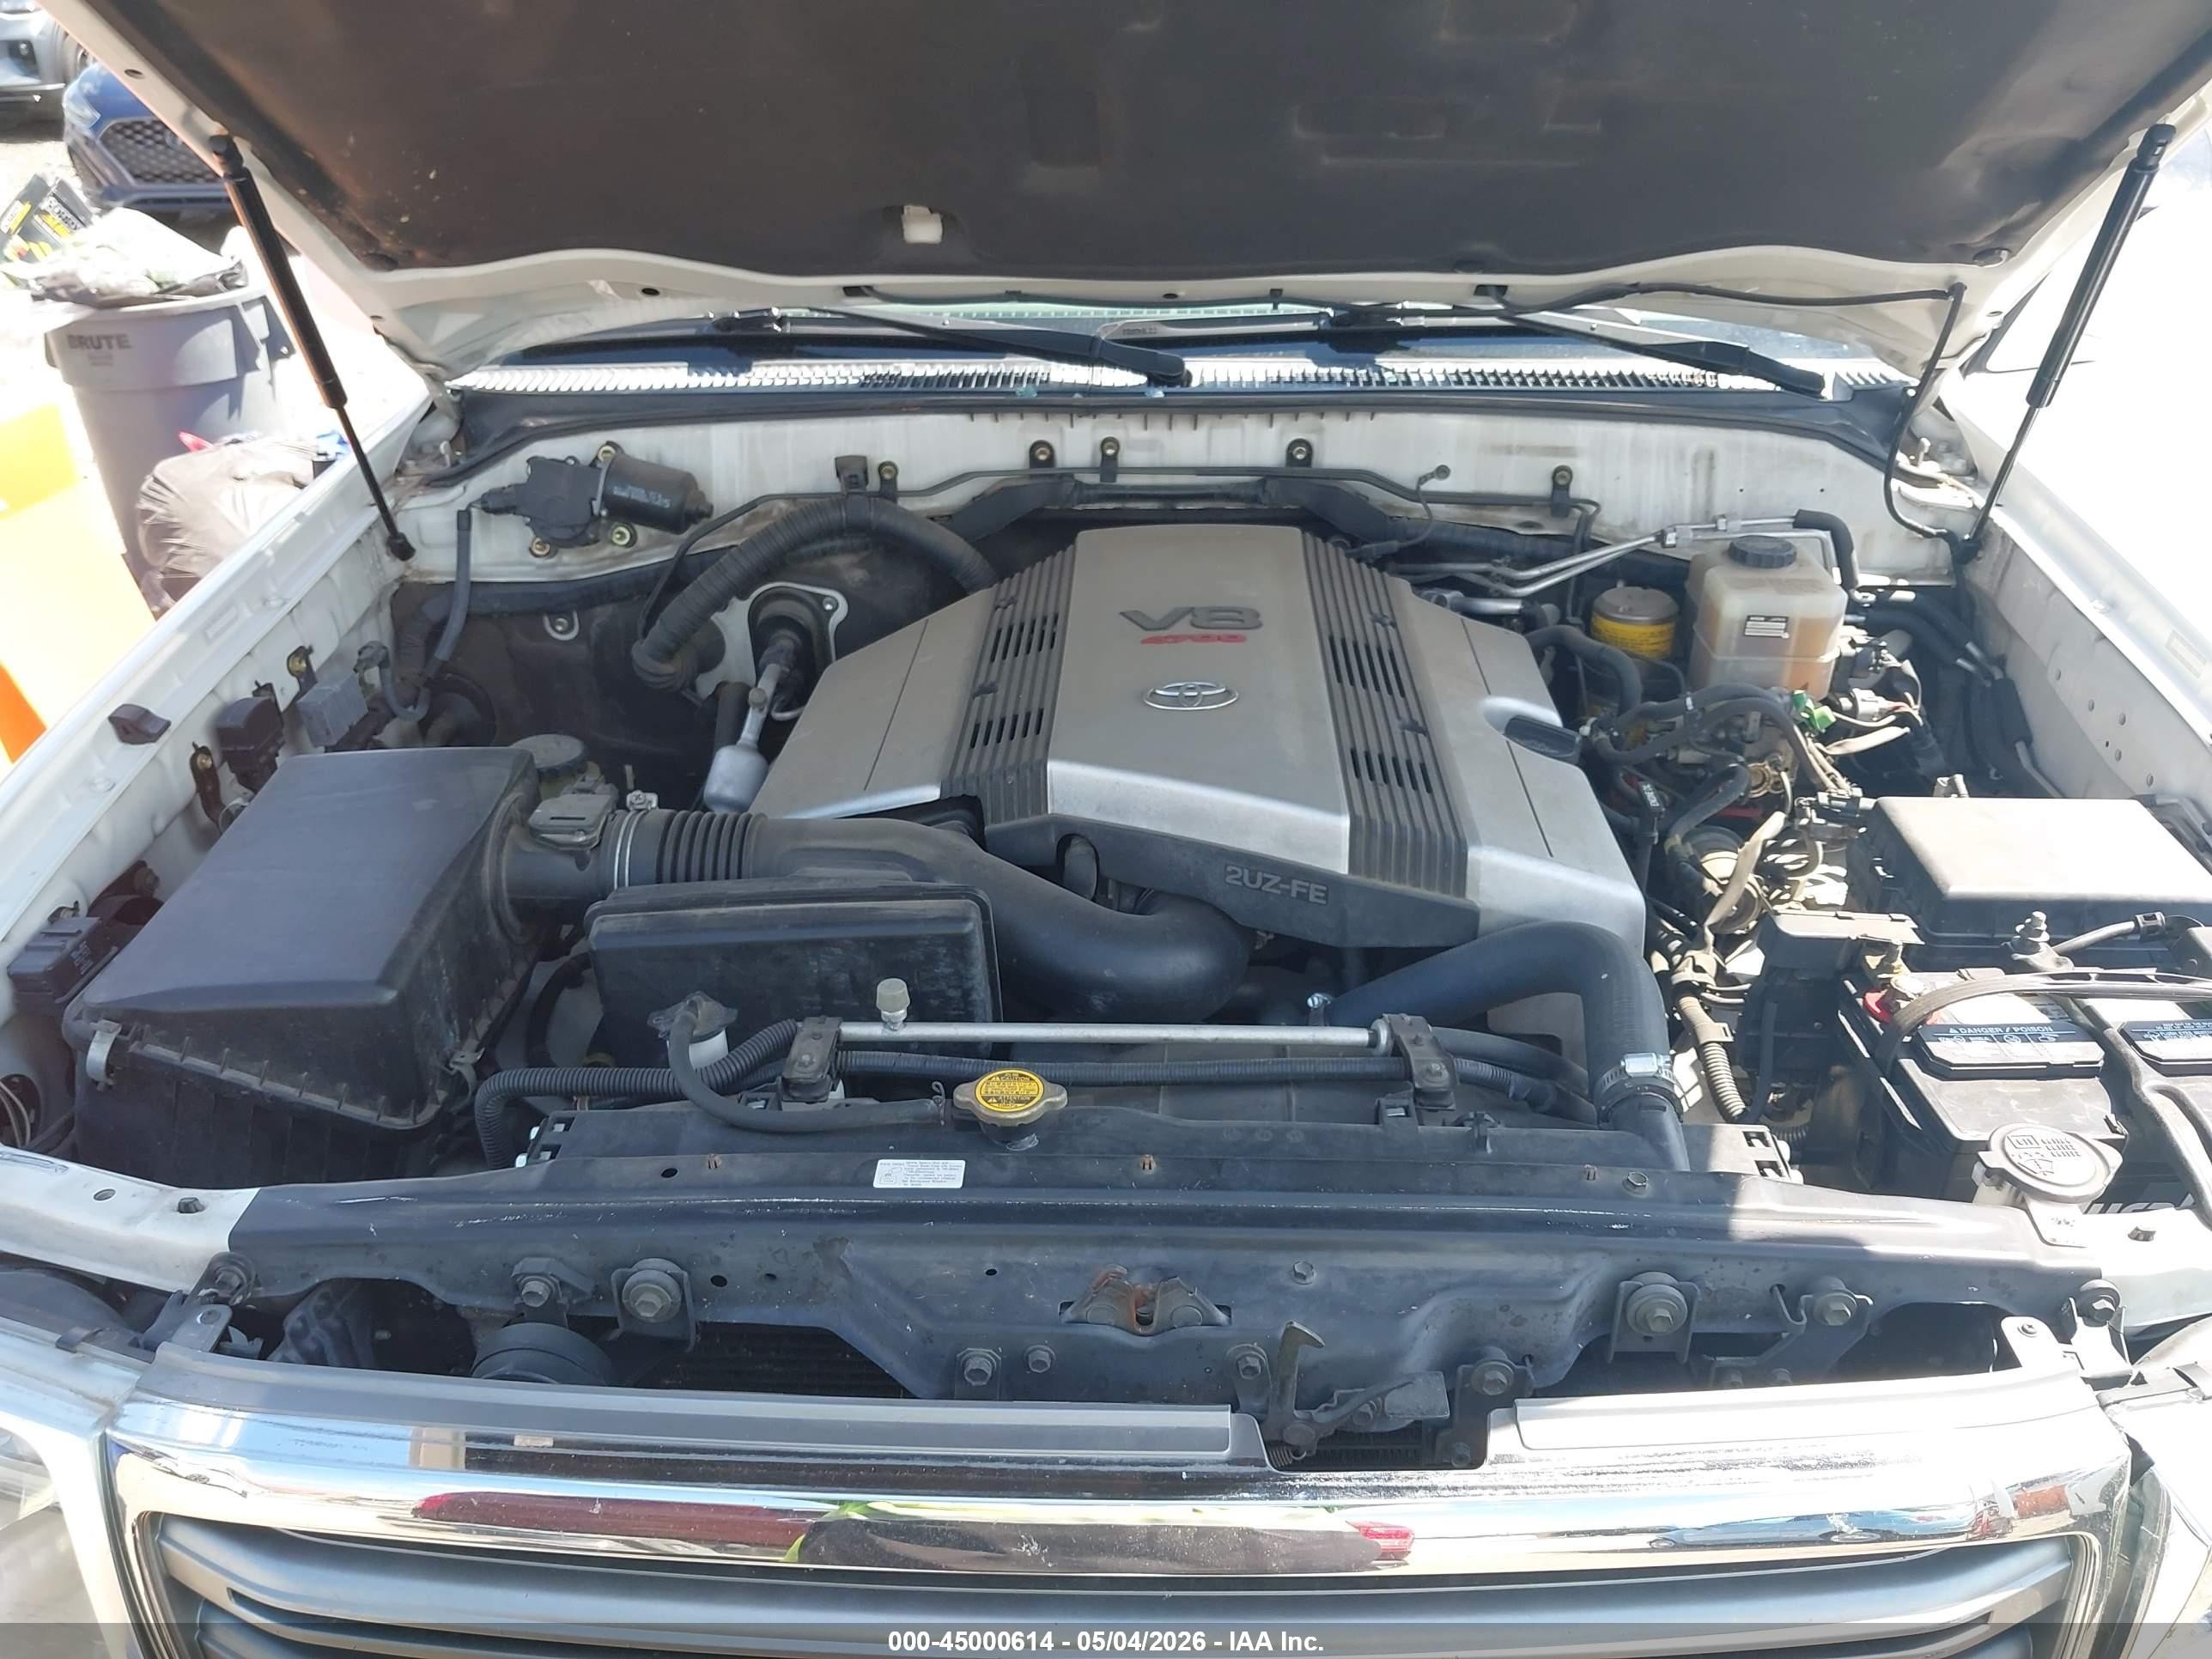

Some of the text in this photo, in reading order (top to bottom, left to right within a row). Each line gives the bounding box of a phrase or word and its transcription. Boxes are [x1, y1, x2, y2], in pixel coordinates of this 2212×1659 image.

[67, 333, 131, 349] BRUTE
[1120, 606, 1262, 630] V8
[1224, 865, 1328, 904] 2UZ-FE
